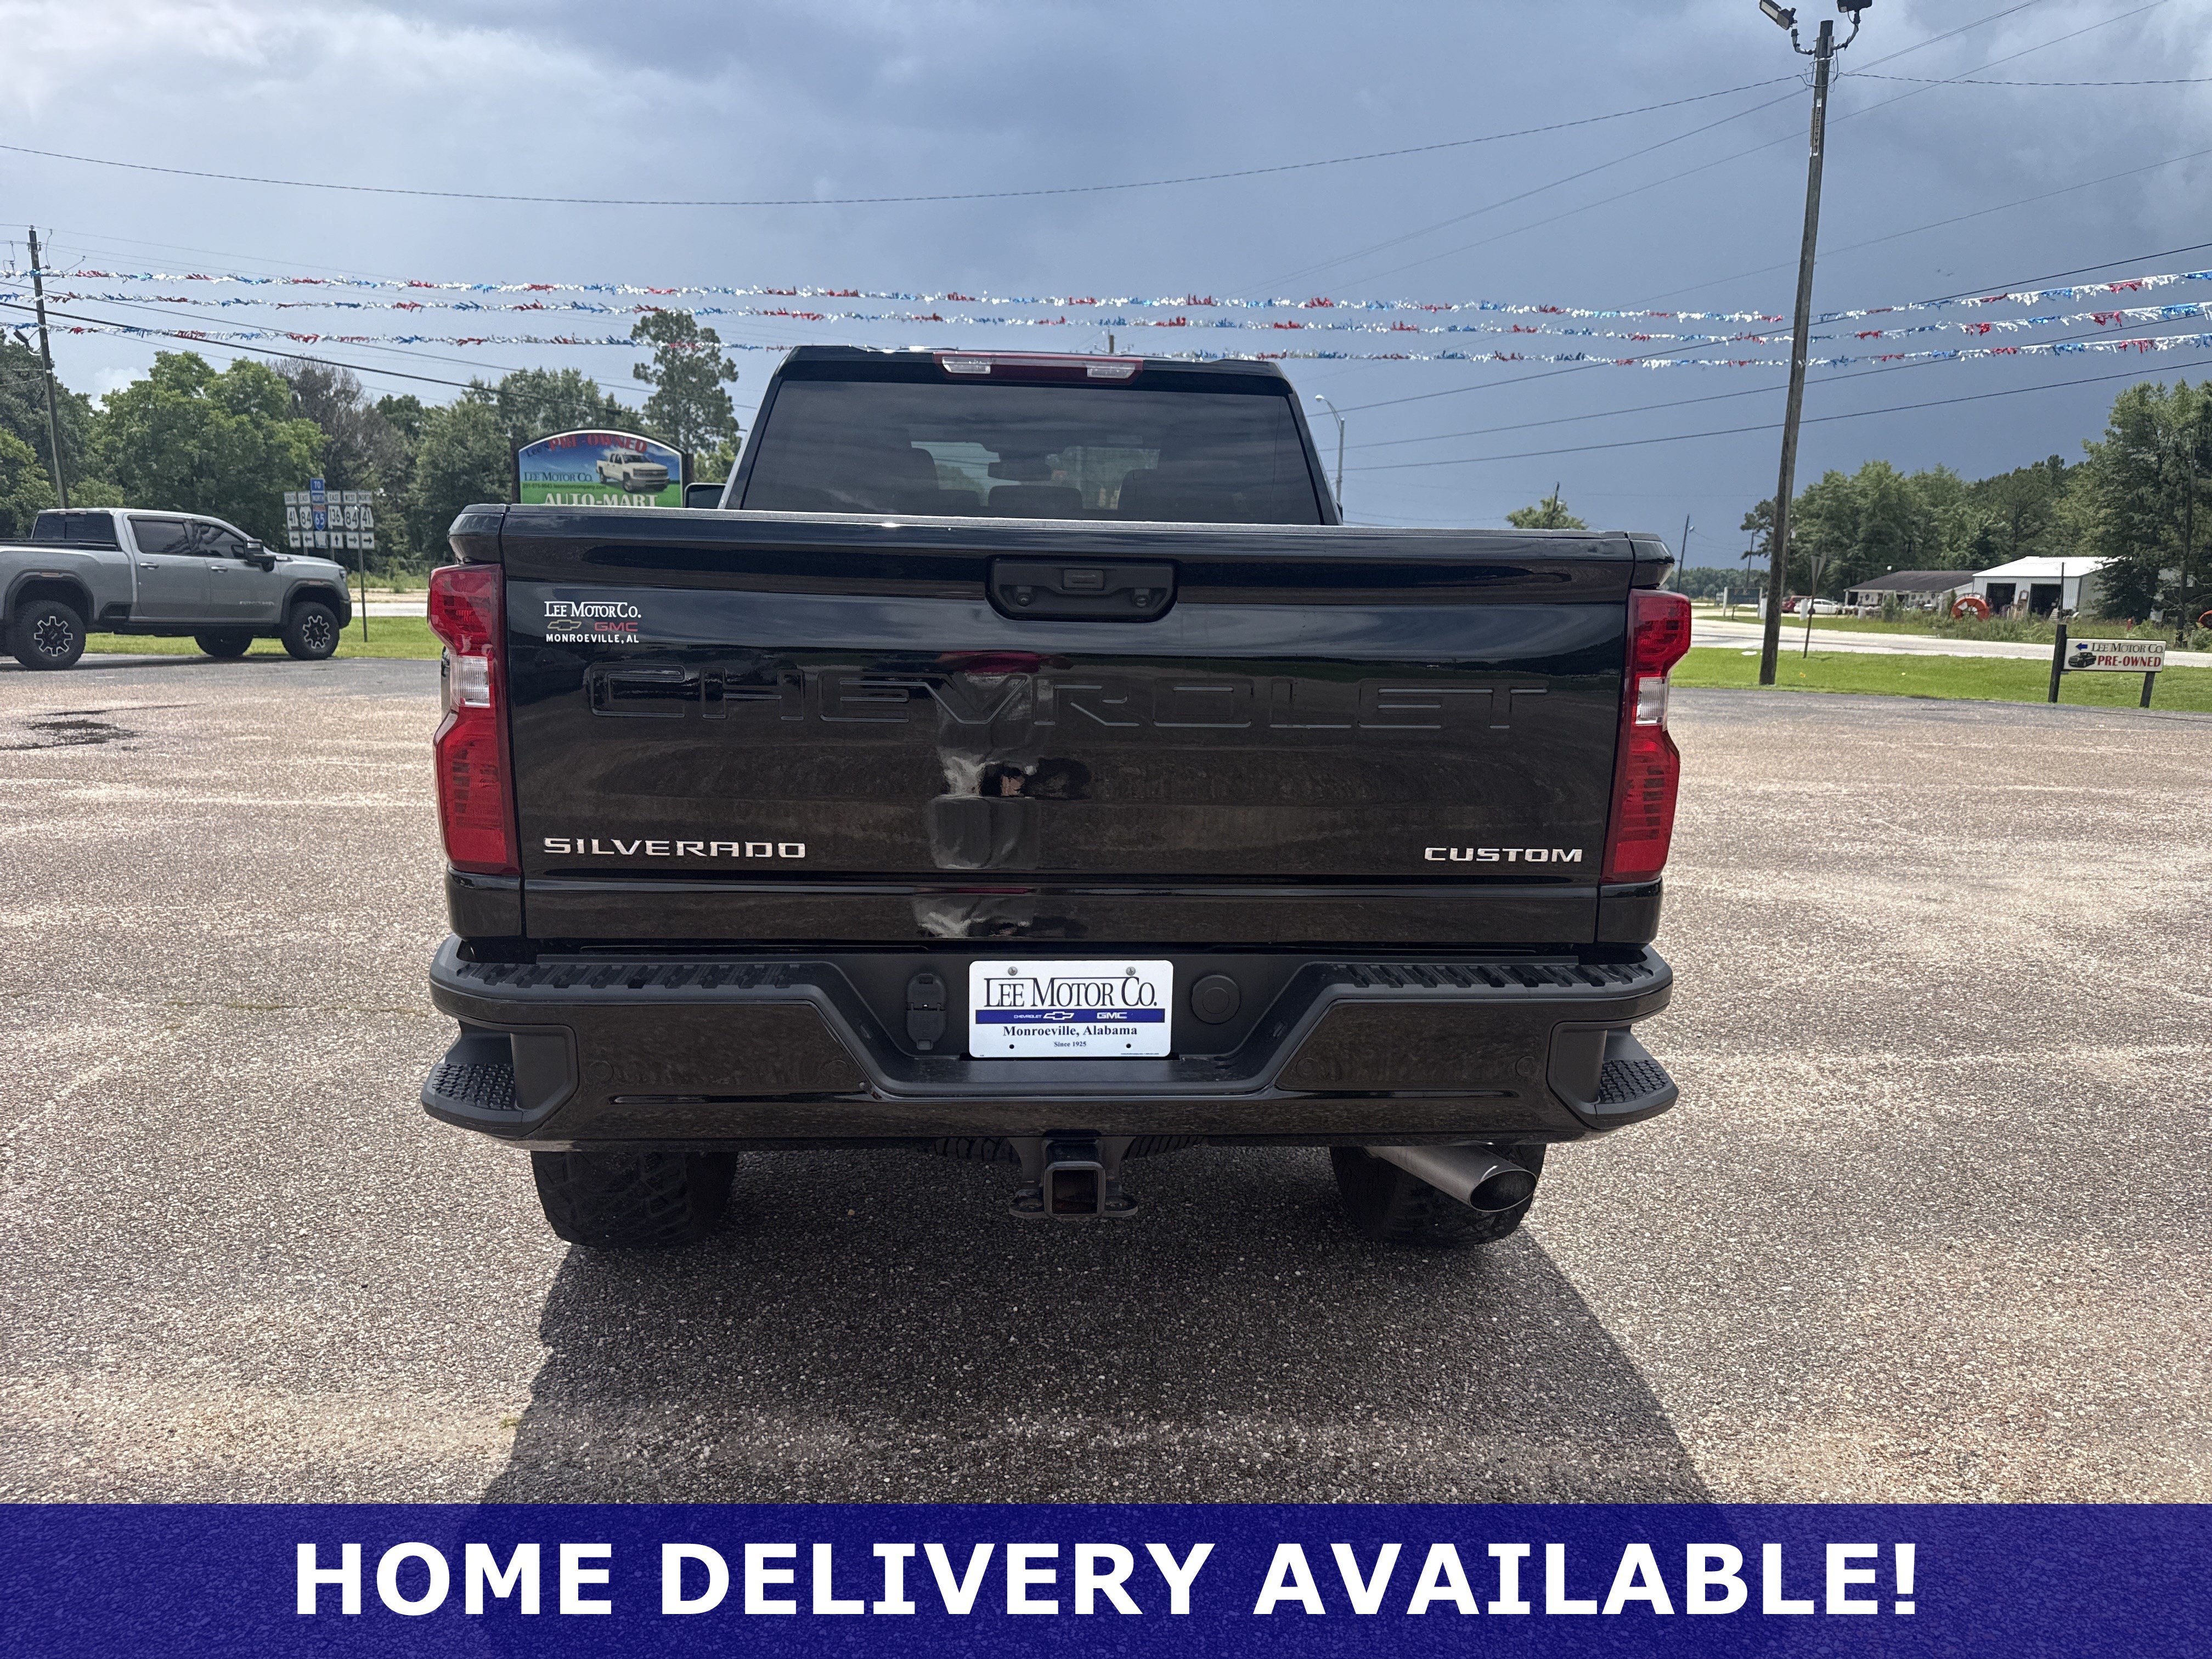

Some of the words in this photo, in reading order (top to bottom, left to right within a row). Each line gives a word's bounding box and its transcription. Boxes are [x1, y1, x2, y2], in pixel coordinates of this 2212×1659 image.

[549, 434, 647, 453] PRE-OWNED
[524, 472, 540, 481] LEE
[542, 472, 575, 482] MOTOR
[314, 481, 321, 489] TO
[545, 493, 658, 506] AUTO-MART
[289, 511, 296, 524] 41
[301, 511, 312, 525] 84
[315, 514, 325, 525] 65
[329, 509, 340, 521] 136
[346, 512, 357, 525] 84
[362, 511, 371, 524] 41
[544, 601, 567, 617] LEE
[571, 601, 616, 618] MOTOR
[594, 622, 638, 632] GMC
[546, 634, 624, 644] MONROEVILLE,
[626, 634, 639, 644] AL
[2091, 642, 2109, 651] LEE
[2110, 643, 2146, 653] MOTOR
[2148, 644, 2164, 653] CO.
[2097, 655, 2162, 667] PRE-OWNED
[588, 663, 1549, 730] CHEVROLET
[543, 837, 806, 859] SILVERADO
[1424, 847, 1583, 862] CUSTOM
[984, 978, 1025, 1008] LEE
[1030, 977, 1115, 1008] MOTOR
[1121, 976, 1158, 1007] CO.
[1003, 1025, 1079, 1037] Monroeville,
[1082, 1025, 1138, 1035] Alabama
